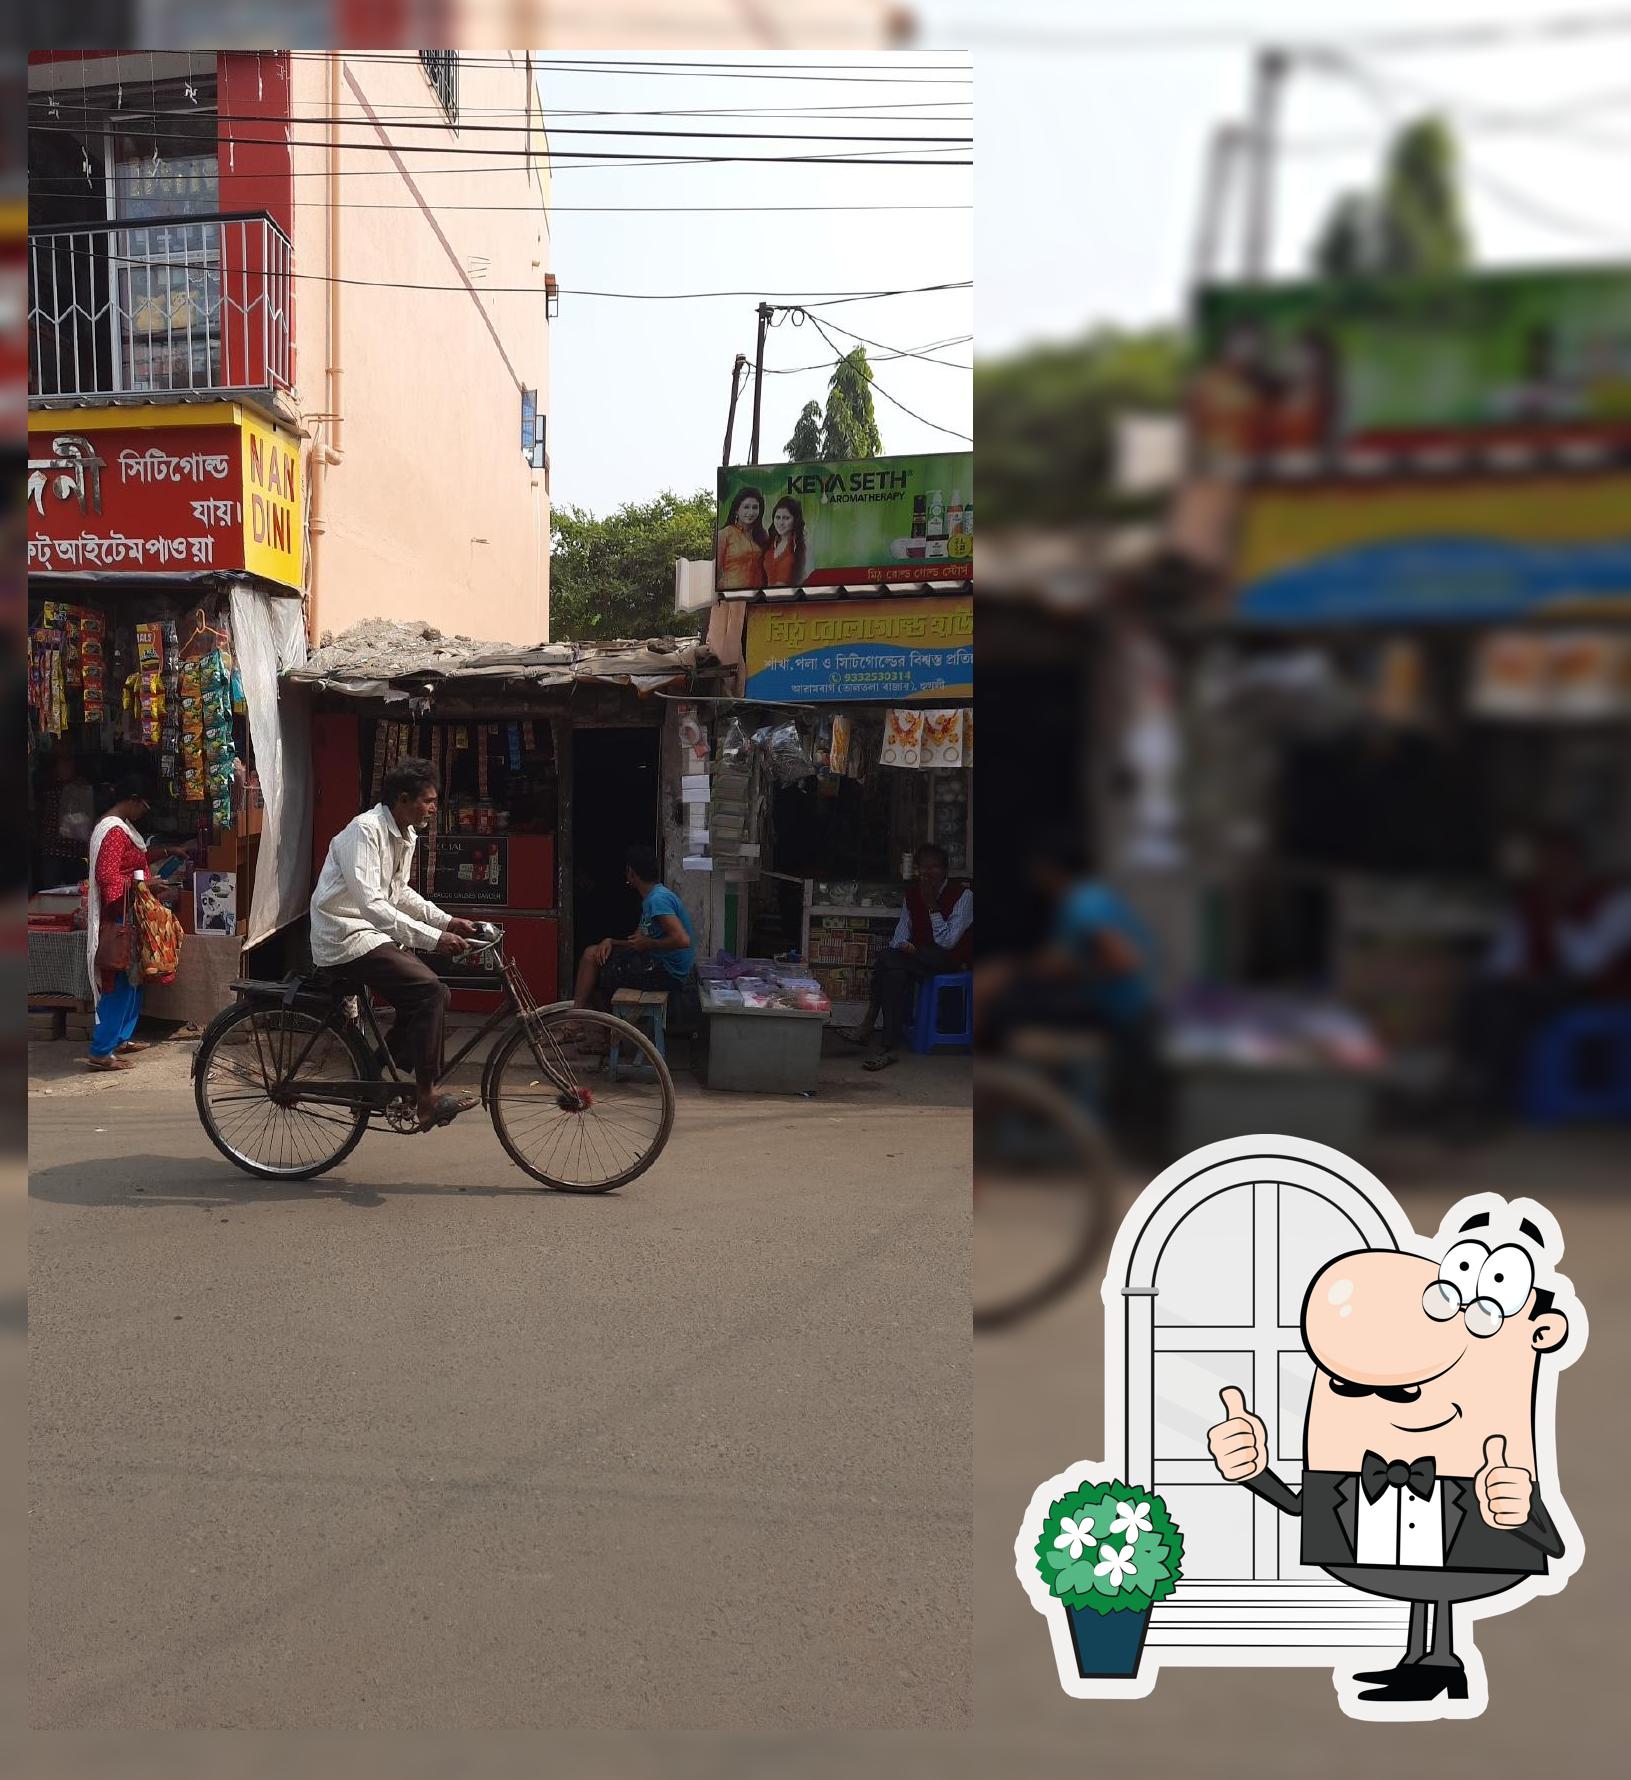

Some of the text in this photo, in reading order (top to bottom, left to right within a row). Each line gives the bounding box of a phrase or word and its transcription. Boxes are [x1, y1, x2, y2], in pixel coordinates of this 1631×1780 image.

[117, 448, 229, 484] সিটিগোল্ড
[250, 433, 295, 502] NAN
[787, 473, 847, 494] KEYA
[829, 492, 906, 504] AROMATHERAPY
[252, 492, 292, 554] DINI
